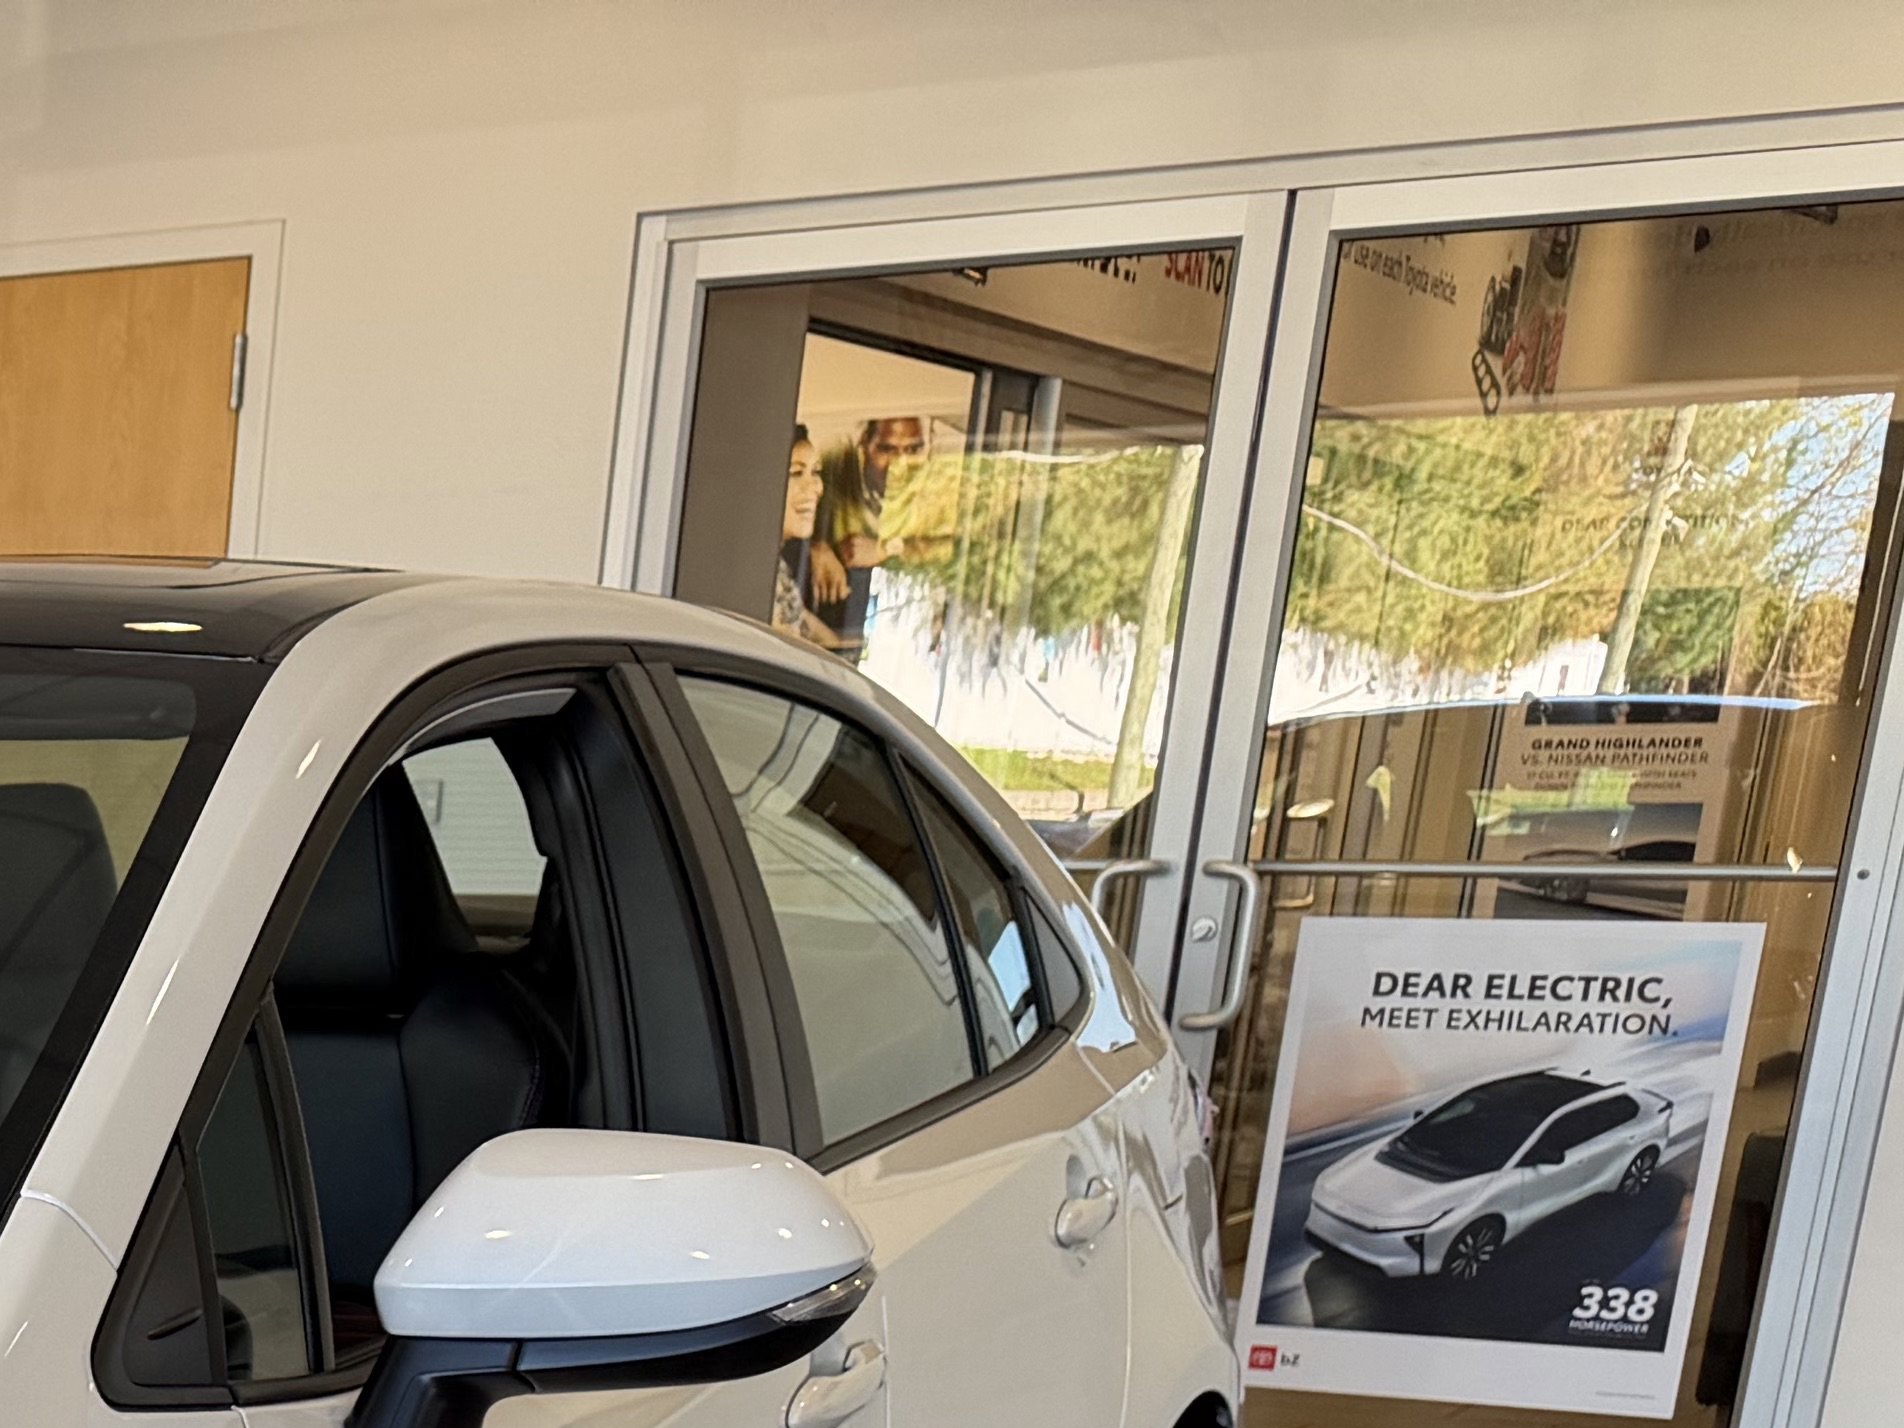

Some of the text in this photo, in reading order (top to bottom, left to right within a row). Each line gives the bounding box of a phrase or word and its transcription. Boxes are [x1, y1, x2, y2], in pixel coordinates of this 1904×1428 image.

[1531, 736, 1704, 751] GRAND HIGHLANDER
[1547, 753, 1607, 766] NISSAN
[1611, 751, 1710, 766] PATHFINDER
[1372, 972, 1673, 1009] DEAR ELECTRIC,
[1360, 1007, 1679, 1037] MEET EXHILARATION.
[1572, 1286, 1659, 1322] 338
